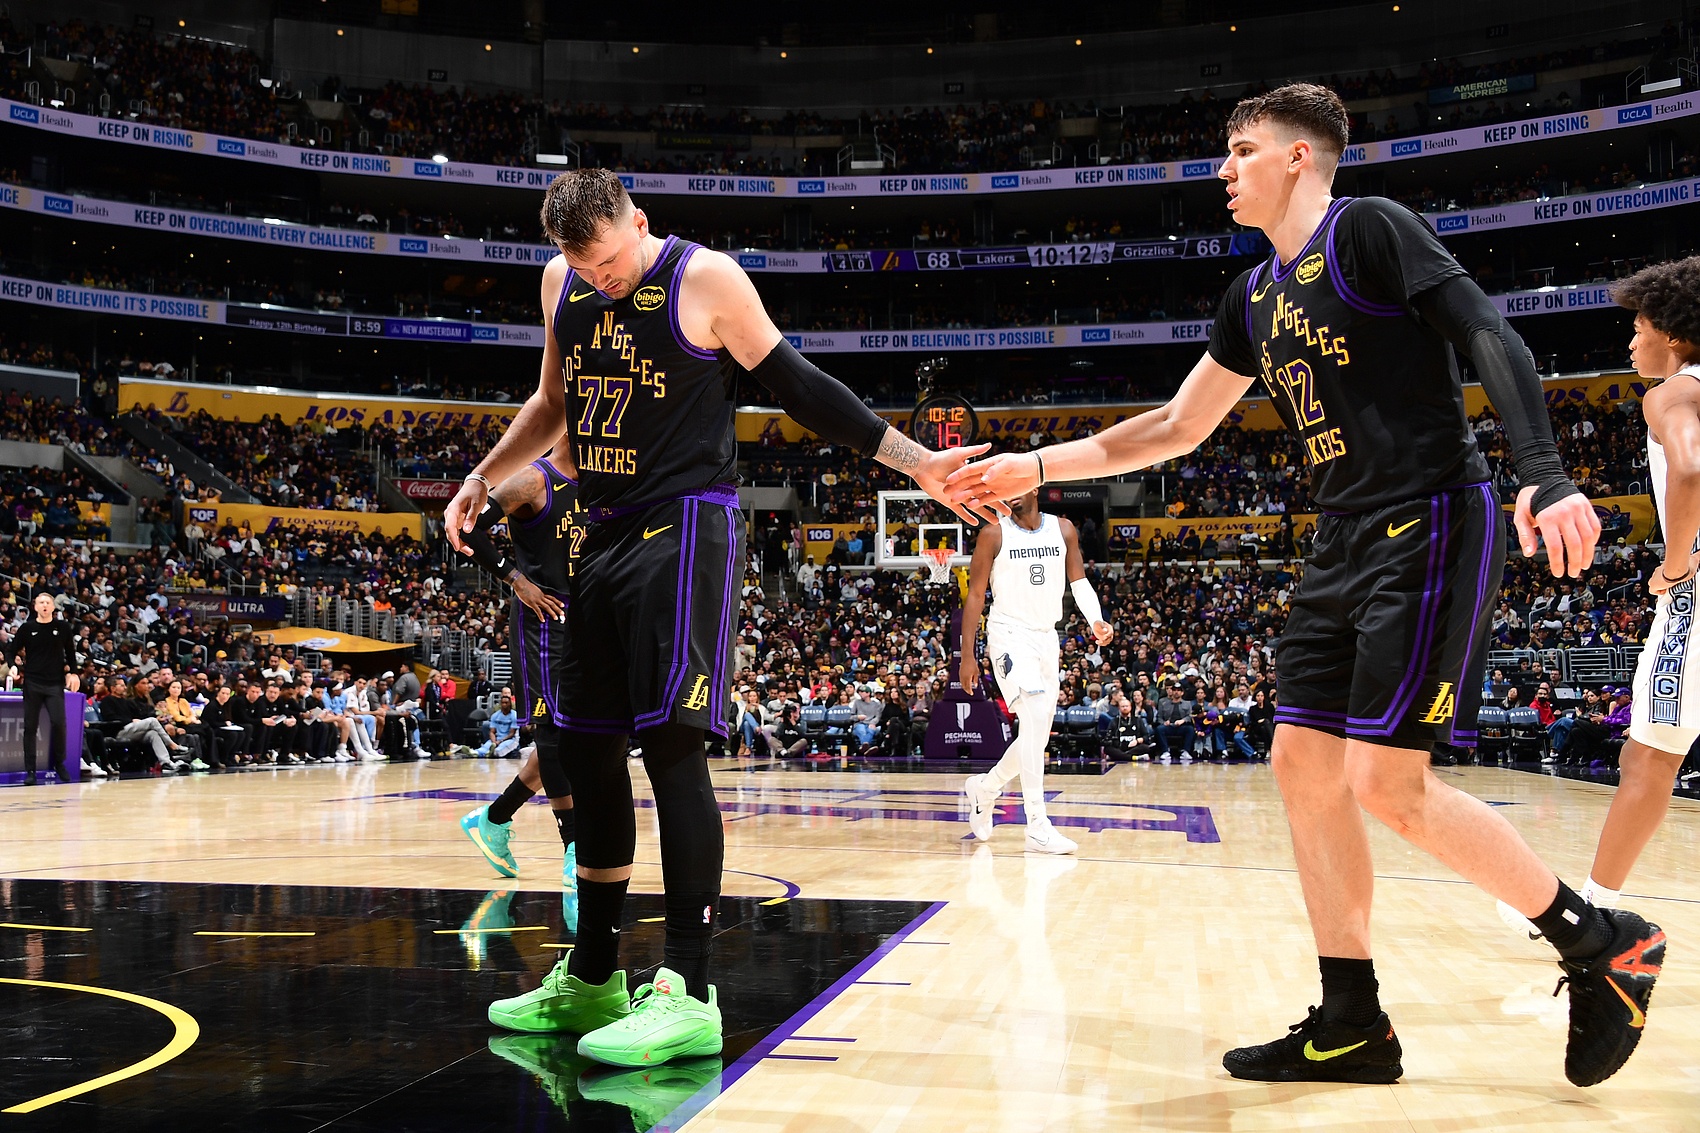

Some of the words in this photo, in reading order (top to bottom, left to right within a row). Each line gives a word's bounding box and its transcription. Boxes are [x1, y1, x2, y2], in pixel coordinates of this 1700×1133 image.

[1452, 78, 1507, 94] AMERICAN
[1460, 85, 1508, 100] EXPRESS
[14, 108, 36, 120] UCLA
[41, 113, 74, 129] Health
[1622, 109, 1648, 122] UCLA
[1655, 100, 1693, 116] Health
[98, 121, 129, 139] KEEP
[133, 126, 150, 142] ON
[154, 130, 193, 149] RISING
[1484, 127, 1517, 143] KEEP
[1521, 125, 1539, 139] ON
[1544, 115, 1589, 135] RISING
[220, 141, 243, 152] UCLA
[247, 146, 278, 160] Health
[1395, 143, 1418, 154] UCLA
[1424, 137, 1458, 150] Health
[300, 152, 329, 168] KEEP
[332, 155, 349, 169] ON
[352, 157, 391, 173] RISING
[1339, 147, 1366, 163] SING
[418, 164, 439, 175] UCLA
[444, 167, 474, 178] Health
[1075, 170, 1104, 184] KEEP
[1107, 169, 1123, 182] ON
[1128, 166, 1167, 180] RISING
[1186, 164, 1207, 174] UCLA
[496, 170, 524, 185] KEEP
[527, 173, 543, 187] ON
[635, 178, 666, 189] Health
[688, 178, 716, 192] KEEP
[719, 178, 735, 192] ON
[738, 178, 775, 193] RISING
[801, 183, 822, 191] UCLA
[827, 181, 857, 192] Health
[880, 178, 907, 192] KEEP
[911, 178, 926, 191] ON
[930, 178, 968, 191] RISING
[995, 178, 1016, 187] UCLA
[1021, 175, 1052, 186] Health
[48, 199, 70, 210] UCLA
[75, 203, 109, 217] Health
[1534, 205, 1568, 221] KEEP
[1573, 202, 1592, 216] ON
[1596, 184, 1689, 212] OVERCOMING
[1440, 218, 1465, 229] UCLA
[1470, 212, 1506, 226] Health
[135, 209, 165, 225] KEEP
[169, 213, 186, 228] ON
[189, 215, 266, 239] OVERCOMING
[270, 226, 306, 244] EVERY
[310, 231, 375, 250] CHALLENGE
[403, 241, 425, 251] UCLA
[430, 244, 461, 255] Health
[484, 245, 512, 260] KEEP
[516, 248, 531, 262] ON
[1034, 246, 1091, 265] 10:12
[1123, 245, 1175, 258] Grizzlies
[1197, 240, 1220, 256] 66
[741, 258, 763, 267] UCLA
[768, 257, 798, 268] Health
[927, 252, 950, 269] 68
[977, 253, 1016, 265] Lakers
[1101, 250, 1110, 263] 3
[839, 260, 846, 270] 4
[857, 260, 865, 270] 0
[1298, 260, 1323, 276] bibigo
[2, 279, 32, 298] KEEP
[36, 285, 53, 301] ON
[56, 288, 120, 309] BELIEVING
[124, 296, 148, 312] IT'S
[151, 298, 209, 319] POSSIBLE
[637, 292, 664, 304] bibigo
[1507, 296, 1540, 313] KEEP
[1545, 294, 1563, 309] ON
[294, 323, 327, 335] Birthday
[354, 321, 381, 333] 8:59
[402, 324, 418, 335] NEW
[418, 325, 461, 338] AMSTERDAM
[1085, 331, 1107, 340] UCLA
[1112, 329, 1144, 340] Health
[1171, 324, 1201, 339] KEEP
[1271, 292, 1350, 366] ANGELES
[475, 330, 495, 338] UCLA
[501, 330, 532, 341] Health
[804, 337, 834, 348] Health
[860, 335, 887, 348] KEEP
[892, 335, 908, 348] ON
[912, 334, 970, 347] BELIEVING
[974, 332, 995, 346] IT'S
[999, 330, 1054, 345] POSSIBLE
[591, 311, 666, 399] ANGELES
[1275, 358, 1326, 431] 12
[304, 404, 367, 424] LOS
[577, 375, 633, 438] 77
[929, 407, 964, 422] 10:12
[938, 422, 962, 449] 16
[577, 443, 637, 475] LAKERS
[1063, 491, 1091, 499] TOYOTA
[286, 517, 308, 525] LOS
[556, 510, 573, 538] LOS
[1197, 524, 1216, 532] LOS
[809, 530, 831, 540] 106
[1009, 546, 1060, 559] memphis
[1029, 564, 1045, 586] 8
[228, 602, 265, 613] ULTRA
